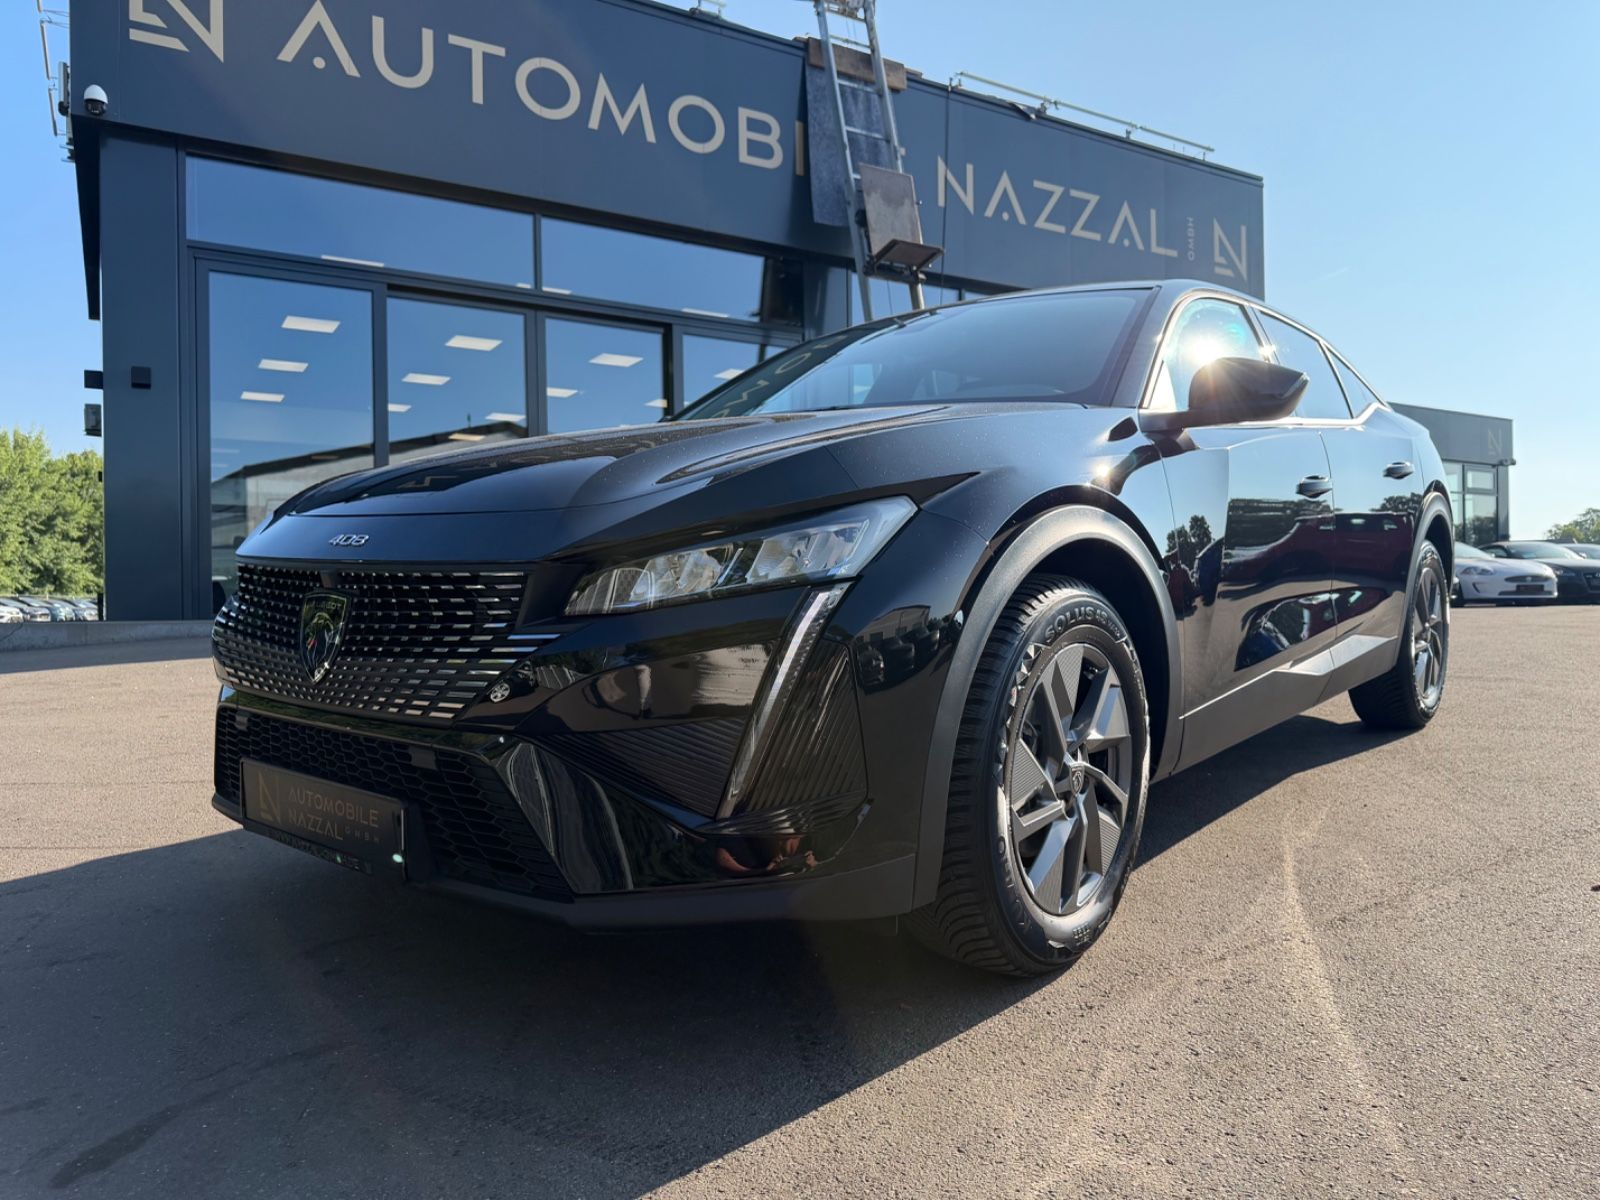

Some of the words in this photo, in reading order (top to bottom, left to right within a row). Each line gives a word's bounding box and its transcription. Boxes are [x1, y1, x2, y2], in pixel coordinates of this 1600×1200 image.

[276, 0, 906, 177] AUTOMOBI
[937, 155, 1178, 257] NAZZAL
[328, 534, 369, 546] 408
[1045, 606, 1095, 643] SOLUS
[288, 786, 379, 828] AUTOMOBILE
[288, 808, 343, 841] NAZZAL
